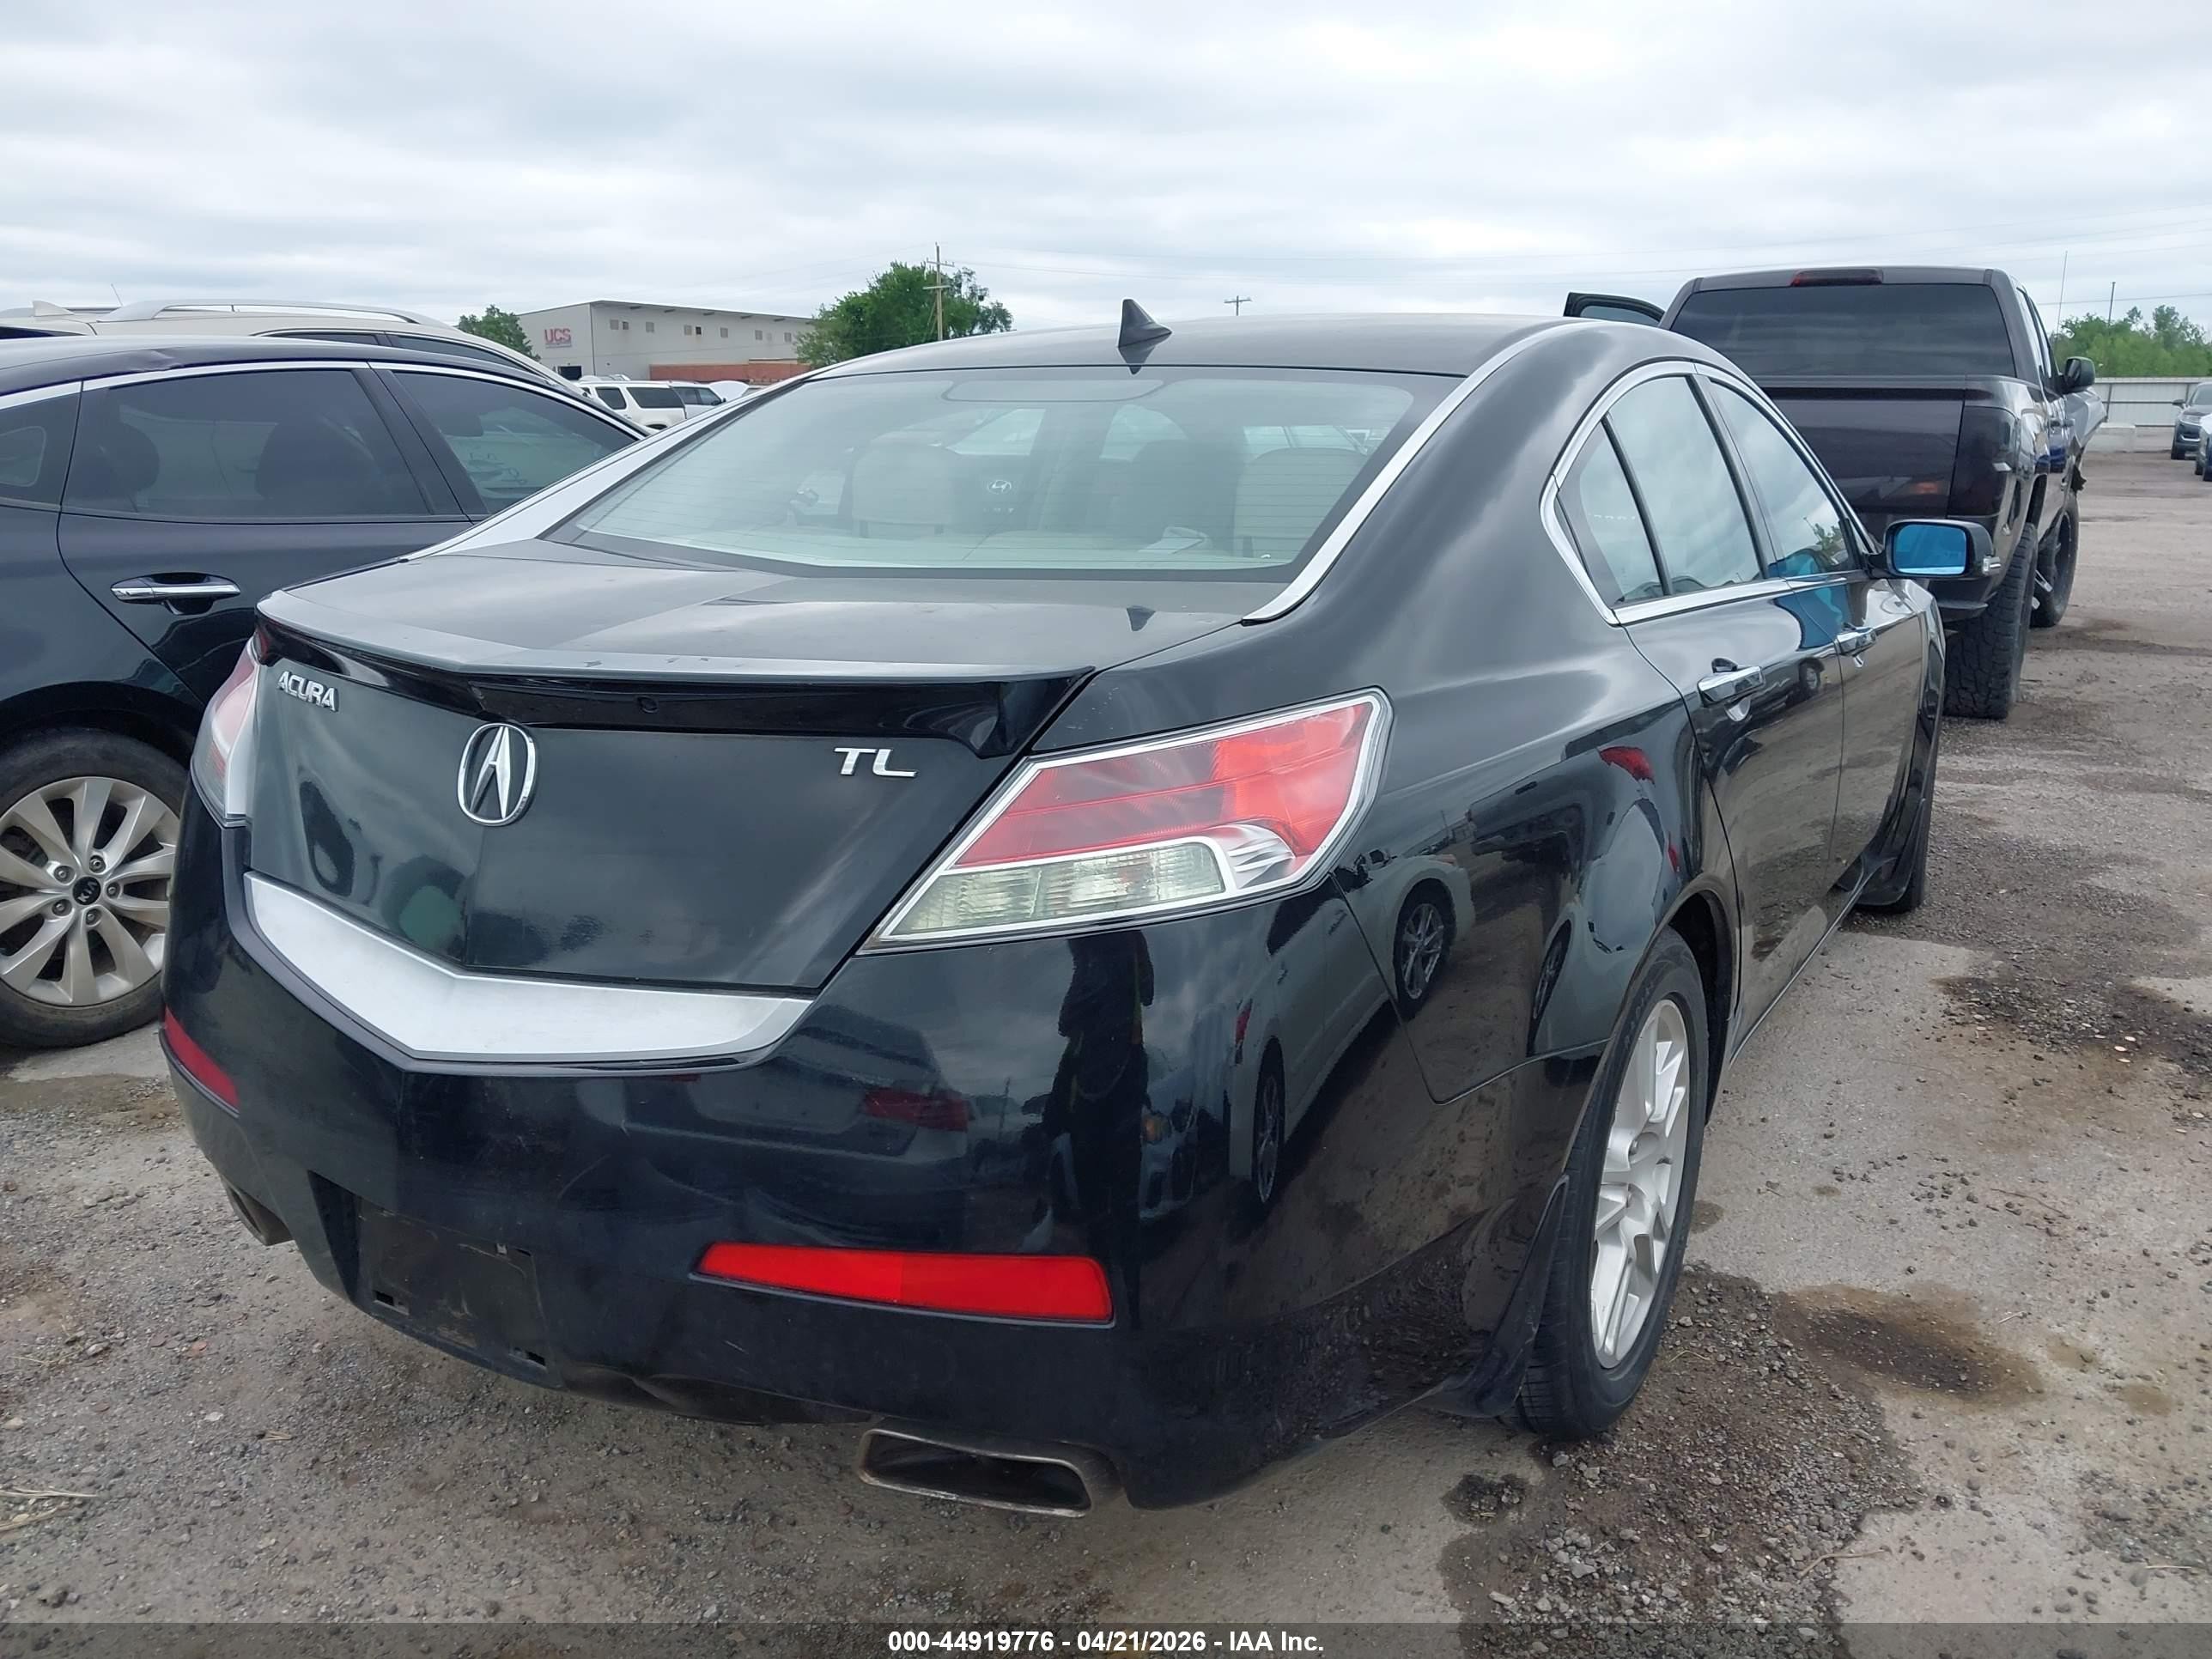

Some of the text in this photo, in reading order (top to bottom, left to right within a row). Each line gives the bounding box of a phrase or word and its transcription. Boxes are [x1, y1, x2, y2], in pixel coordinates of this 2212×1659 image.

[544, 328, 571, 343] UCS
[277, 671, 337, 712] ACURA
[834, 747, 917, 777] TL
[77, 881, 98, 902] KIA
